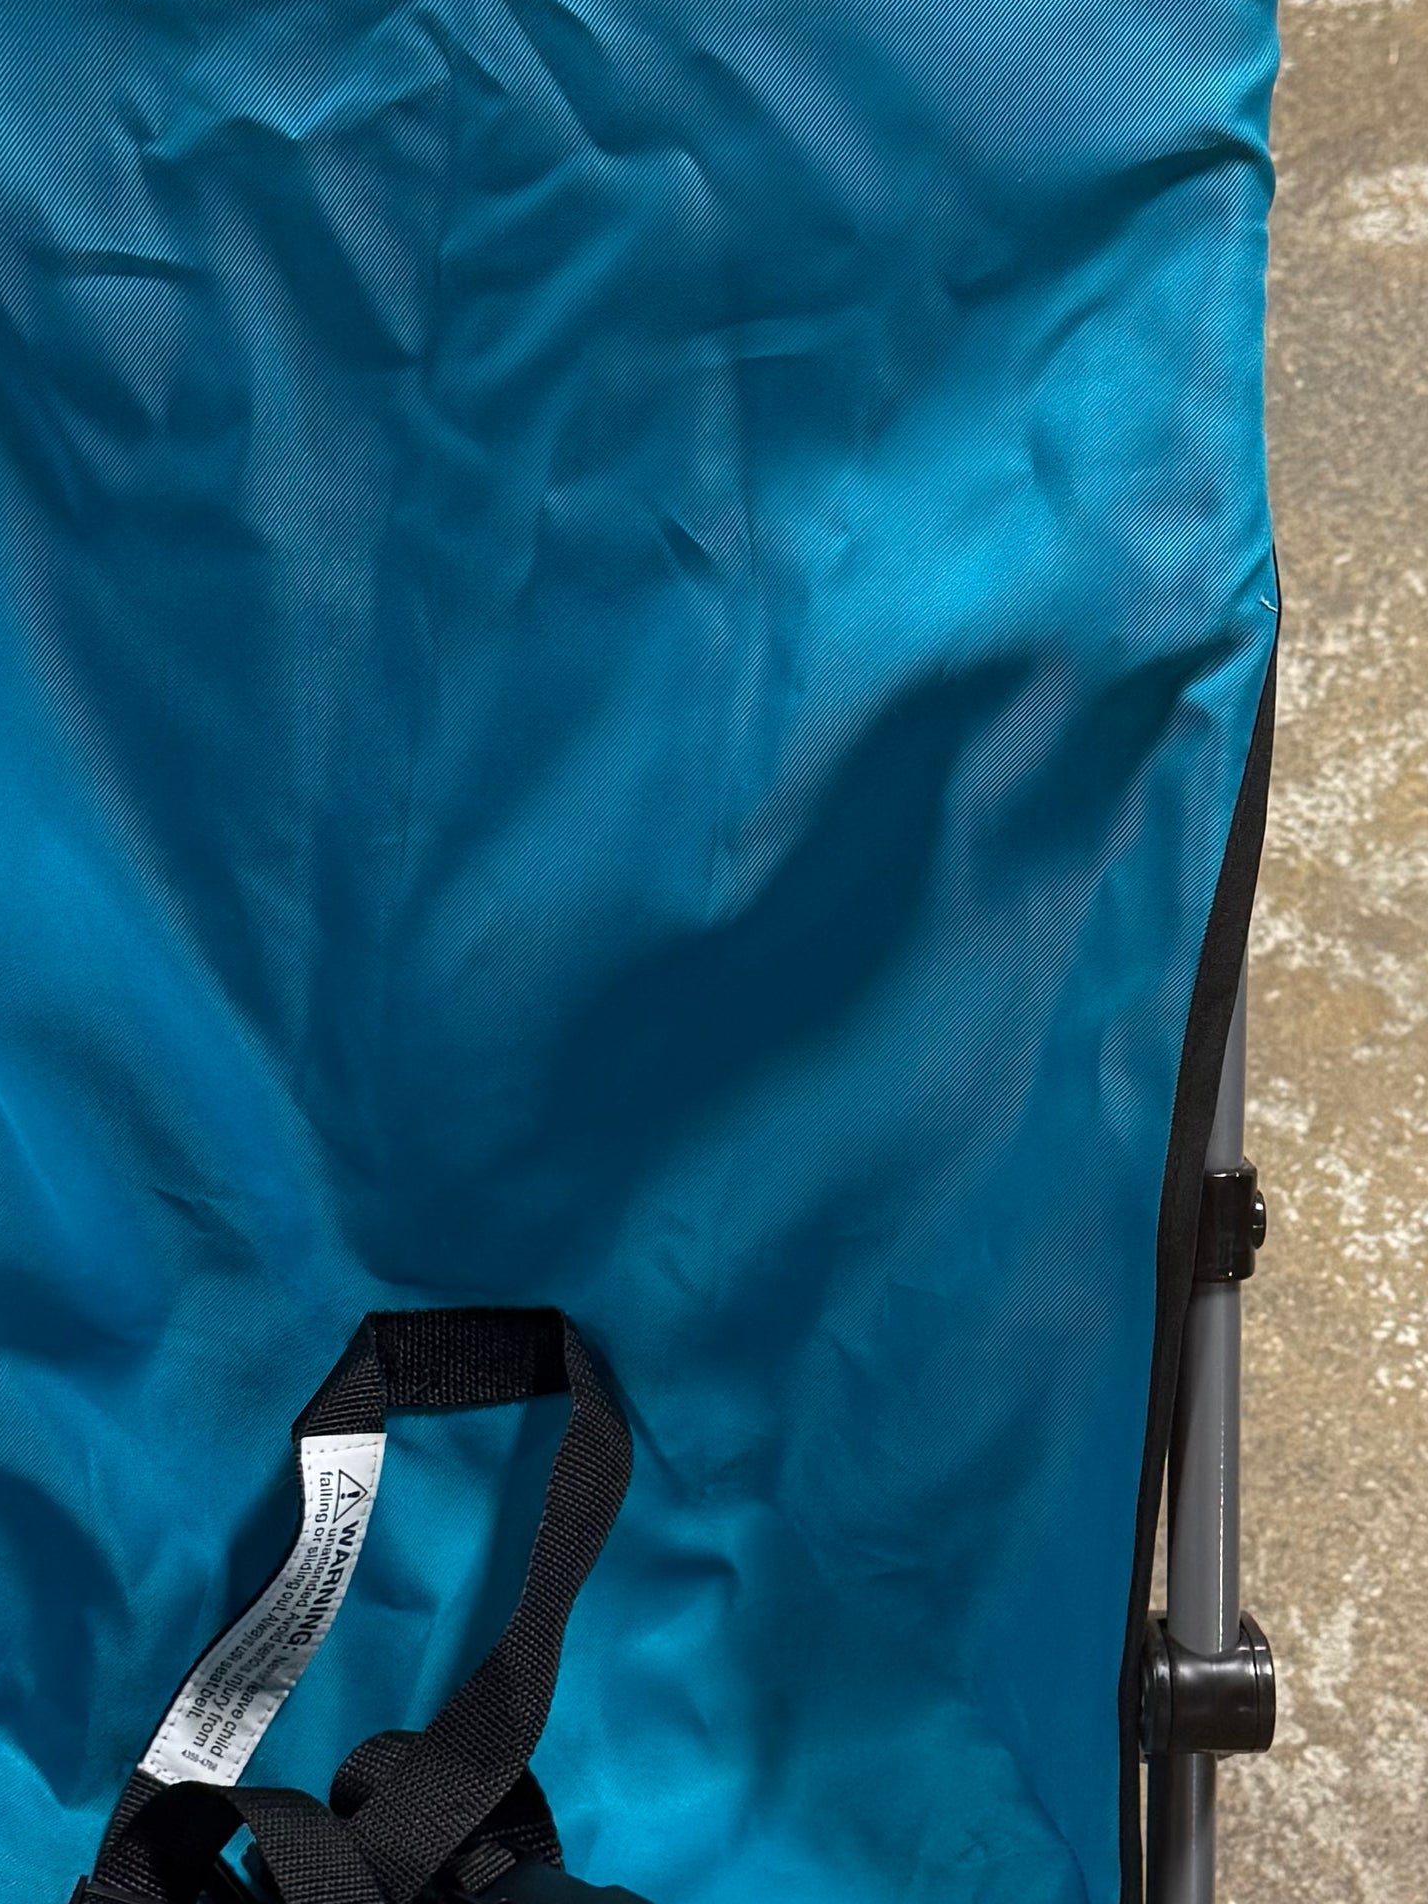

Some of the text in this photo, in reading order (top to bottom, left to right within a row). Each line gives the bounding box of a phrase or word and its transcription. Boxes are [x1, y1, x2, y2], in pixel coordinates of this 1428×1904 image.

[314, 1471, 334, 1523] falling
[312, 1527, 325, 1544] or
[283, 1520, 360, 1652] WARNING:
[285, 1546, 319, 1591] sliding
[210, 1658, 233, 1688] seat
[213, 1671, 248, 1712] injury
[186, 1687, 217, 1718] belt.
[231, 1681, 265, 1720] leave
[193, 1712, 224, 1747] from
[210, 1720, 237, 1758] child
